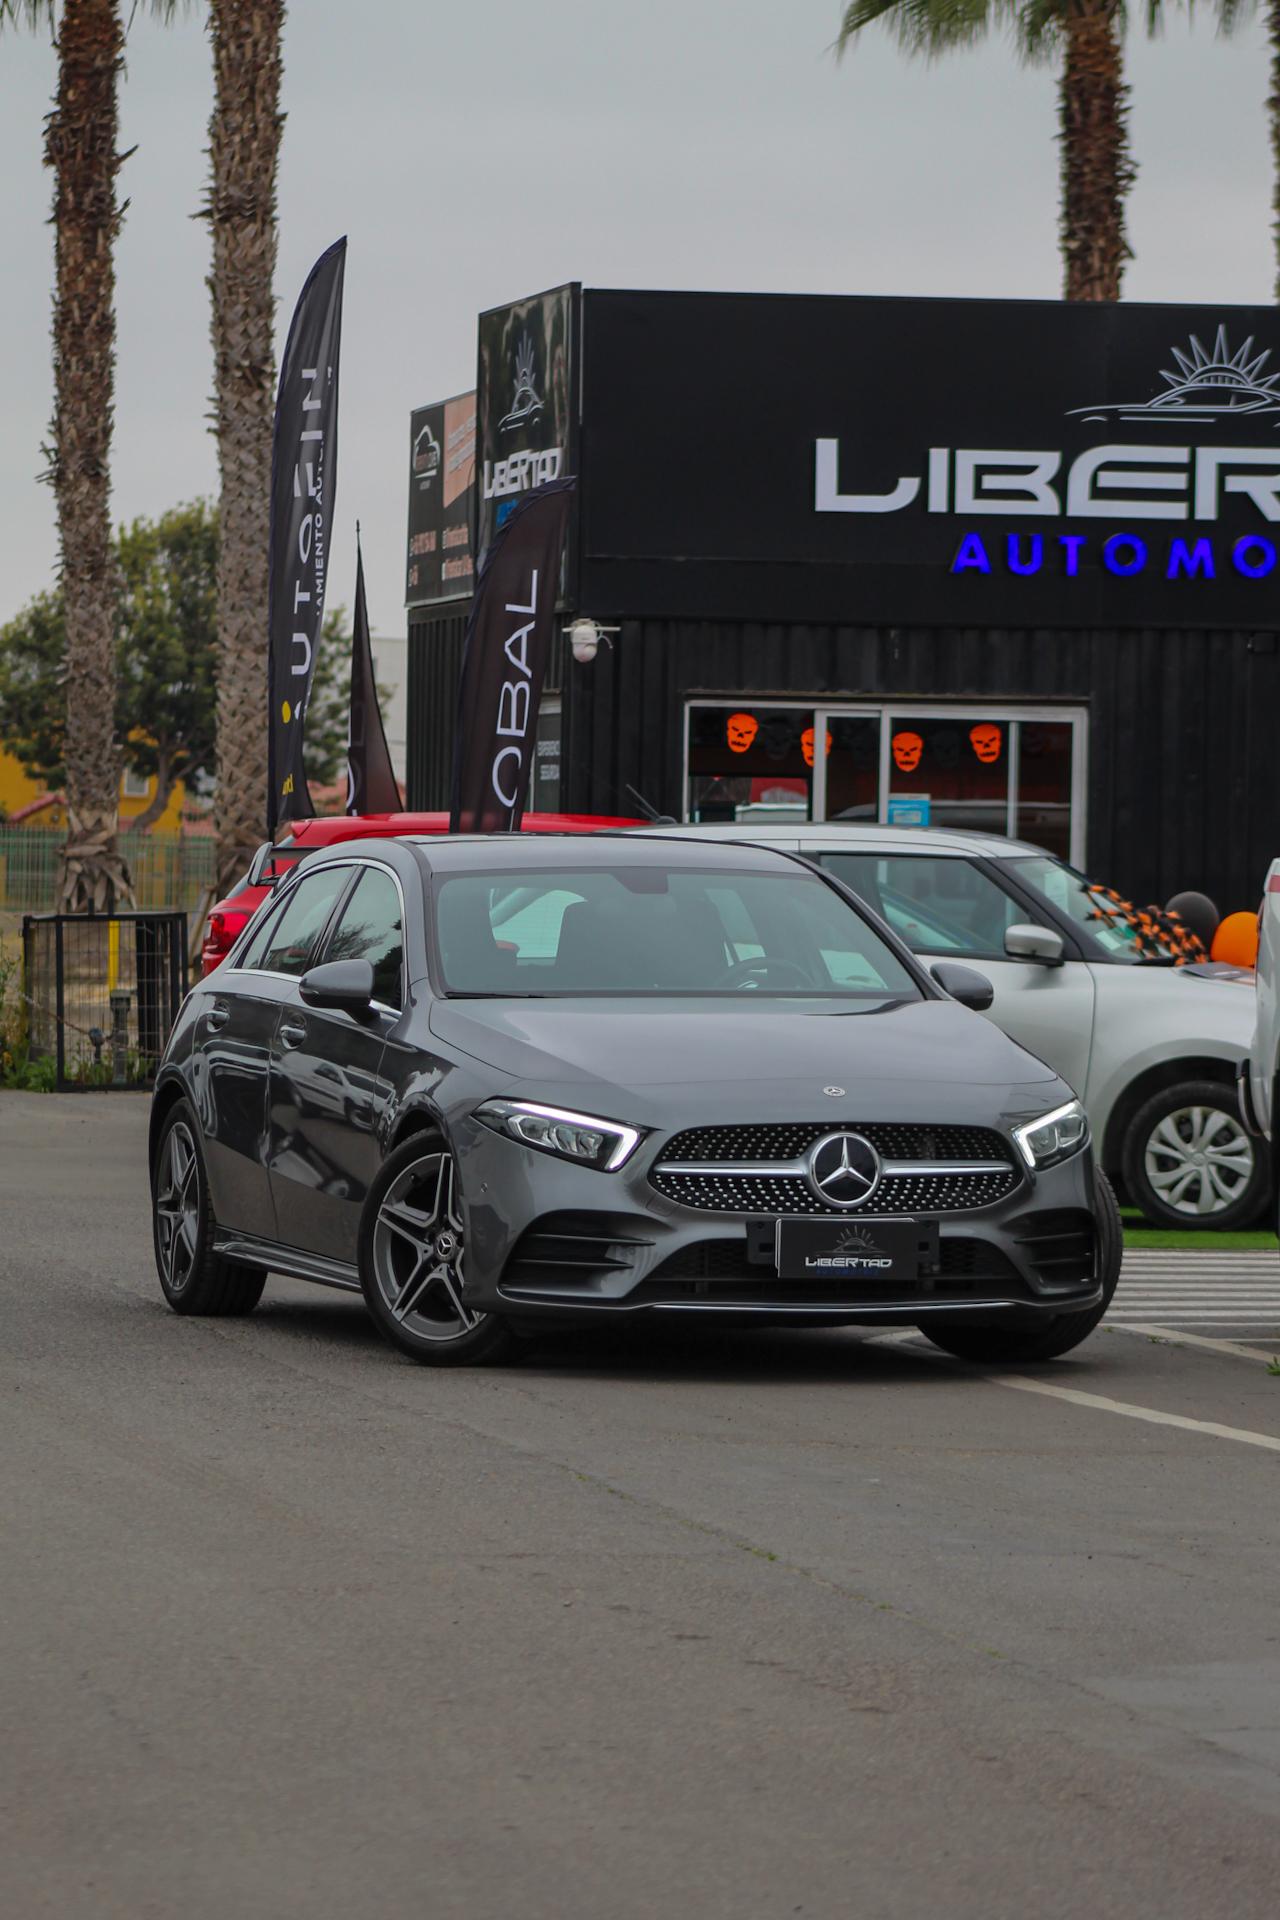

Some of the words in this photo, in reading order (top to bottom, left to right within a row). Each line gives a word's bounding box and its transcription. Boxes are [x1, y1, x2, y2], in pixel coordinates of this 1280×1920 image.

[949, 532, 1277, 579] AUTOMO
[492, 568, 539, 825] OBAL
[804, 1256, 893, 1268] LIBERTAD
